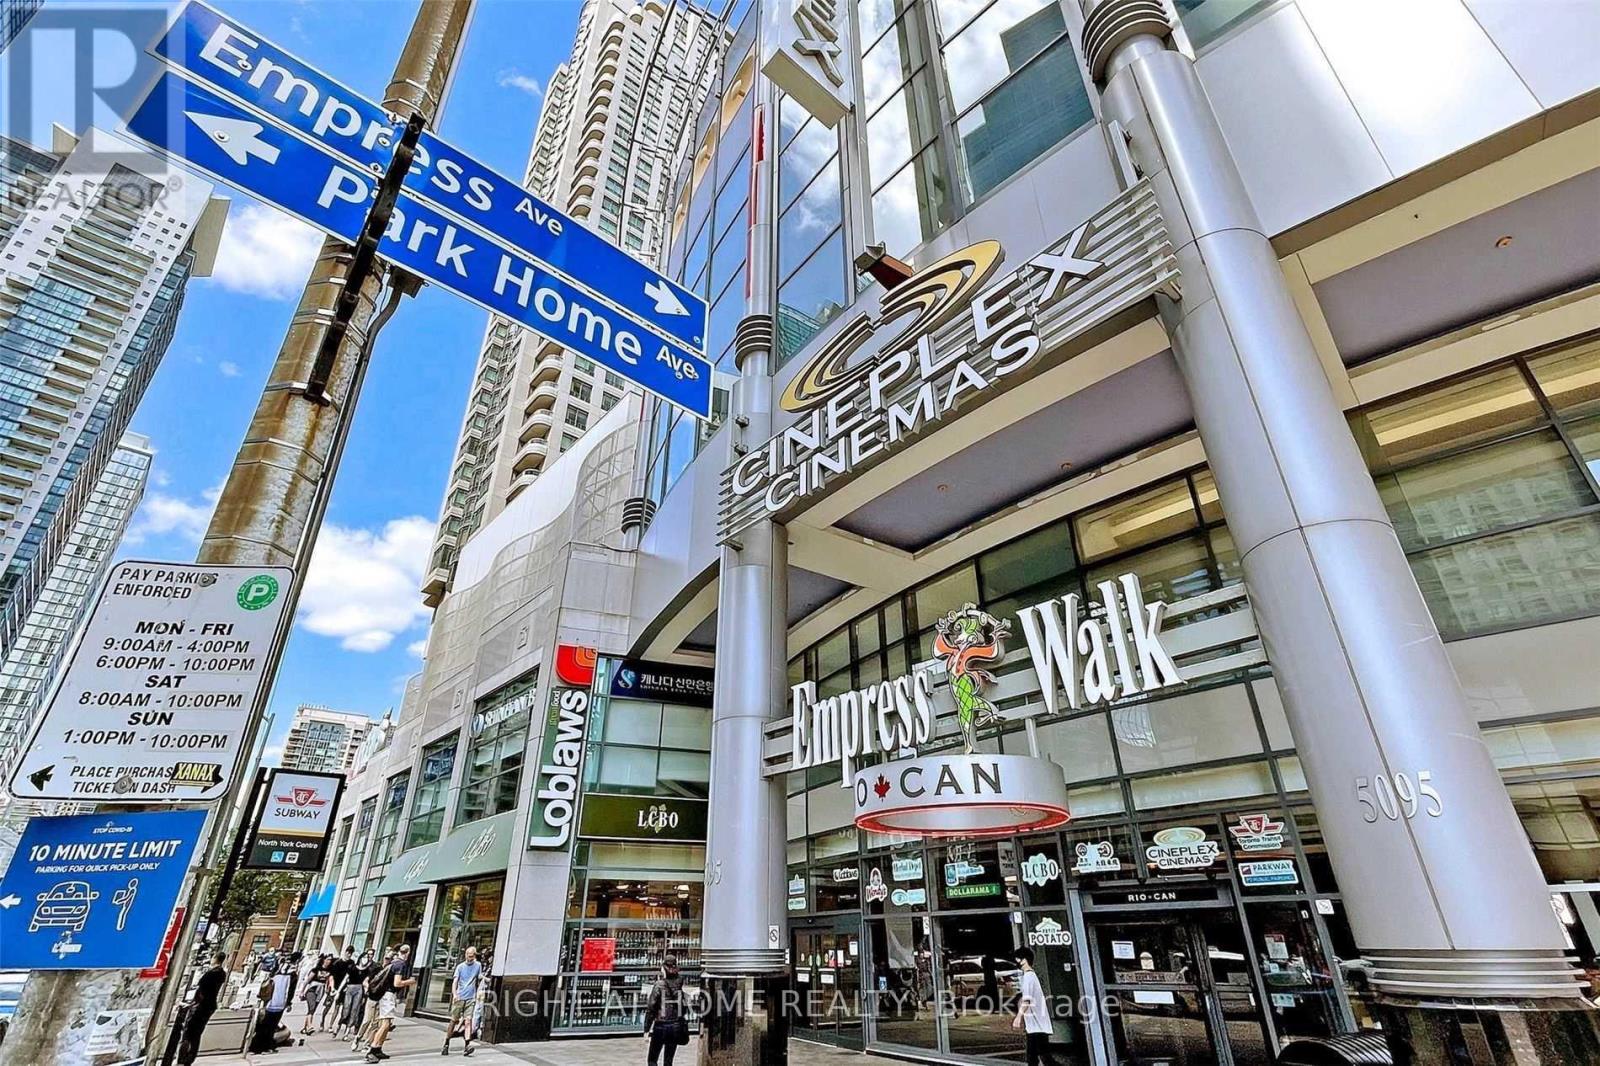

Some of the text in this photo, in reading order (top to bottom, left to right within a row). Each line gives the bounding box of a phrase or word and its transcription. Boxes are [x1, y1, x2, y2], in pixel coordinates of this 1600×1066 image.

[199, 22, 563, 237] Empress Ave
[316, 165, 695, 379] Park Home Ave
[732, 222, 1103, 496] CINEPLEX
[764, 327, 1044, 513] CINEMAS
[120, 568, 219, 585] PAY PARKIG
[113, 583, 192, 599] ENFORCED
[135, 621, 184, 635] MON
[201, 623, 234, 635] FRI
[103, 638, 173, 652] 9:00AM
[187, 640, 249, 653] 4:00PM
[1016, 572, 1188, 715] Walk
[96, 655, 166, 669] 6:00PM
[183, 658, 255, 671] 10:00PM
[145, 675, 186, 688] SAT
[78, 692, 150, 707] 8:00AM
[168, 694, 242, 707] 10:00PM
[127, 712, 173, 726] SUN
[790, 669, 936, 789] Empress
[63, 729, 135, 745] 1:00PM
[151, 734, 228, 749] 10:00PM
[70, 766, 174, 778] PLACE PURCHAS
[174, 764, 217, 780] XANAX
[531, 690, 588, 849] Loblaws
[73, 781, 116, 793] TICKET
[141, 782, 176, 793] DASH
[900, 762, 1002, 797] CAN
[1355, 770, 1443, 823] 5095
[275, 808, 320, 819] SUBWAY
[638, 810, 679, 828] LCBO
[29, 840, 181, 861] 10 MINUTE LIMIT
[295, 841, 318, 849] Centre
[1148, 844, 1216, 858] CINEPLEX
[35, 862, 160, 873] PARKING FOR QUICK PICK-UP ONLY
[1159, 856, 1211, 867] CINEMAS
[1024, 862, 1057, 879] LCBO
[949, 886, 989, 896] DOLLARAMA
[1031, 933, 1070, 943] POTATO
